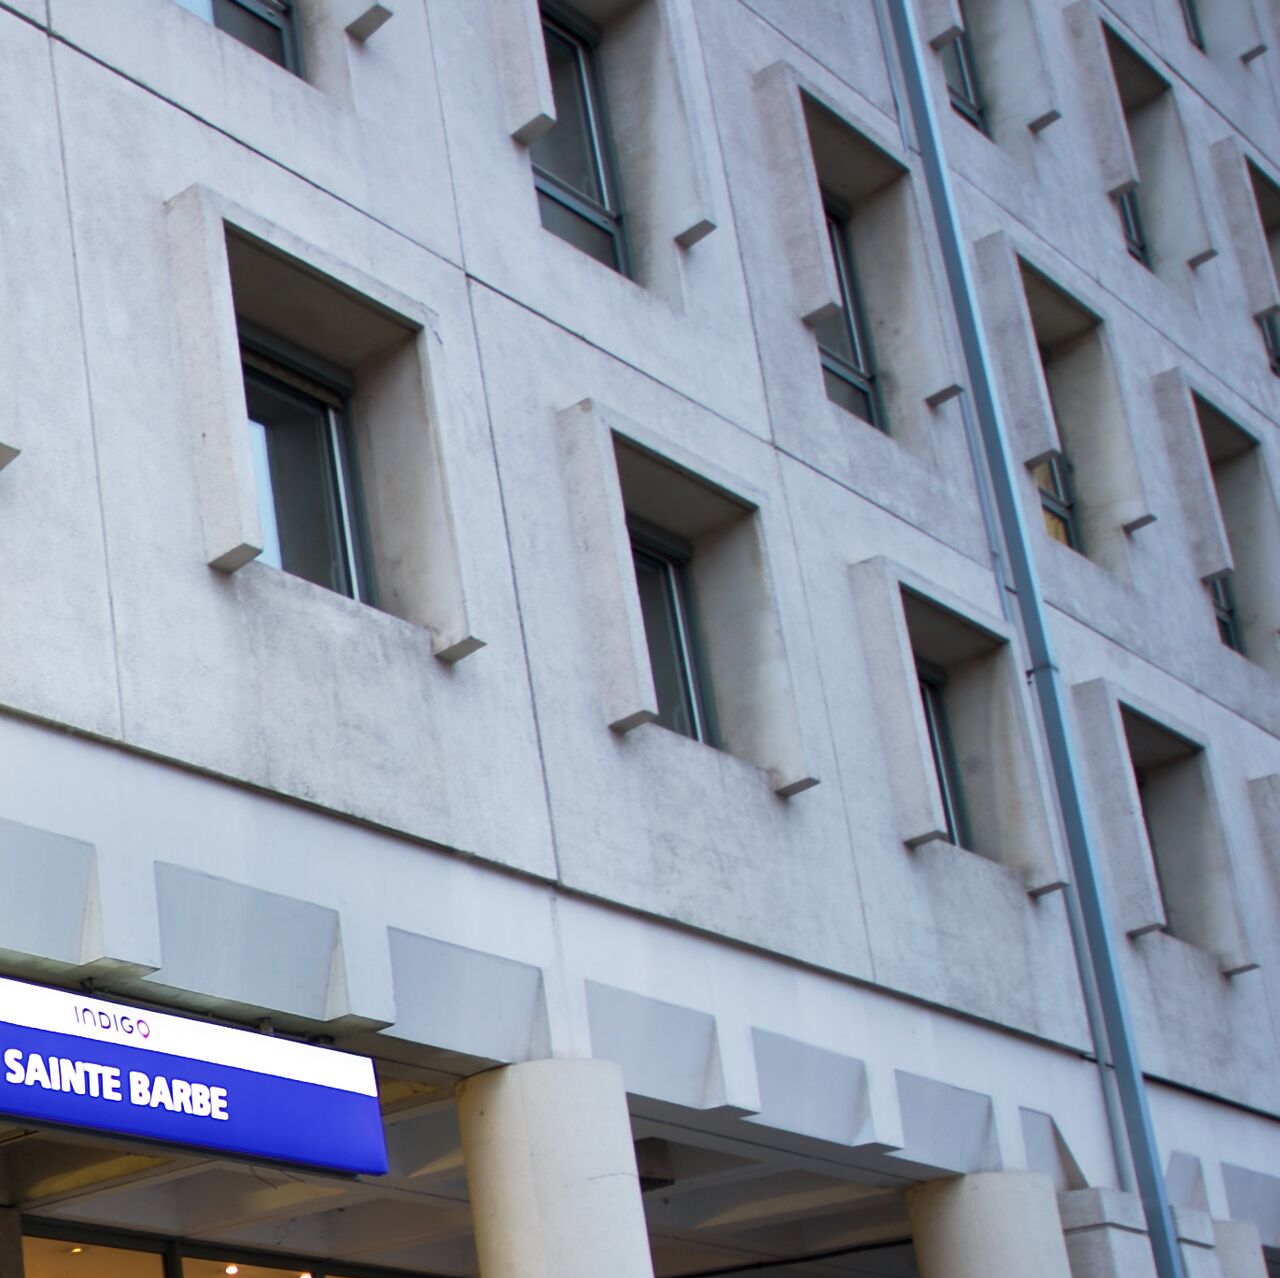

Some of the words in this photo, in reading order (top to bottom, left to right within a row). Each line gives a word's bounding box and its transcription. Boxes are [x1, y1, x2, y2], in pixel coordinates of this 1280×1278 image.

[74, 1005, 150, 1039] INDIGO
[3, 1048, 122, 1103] SAINTE
[129, 1069, 229, 1122] BARBE
